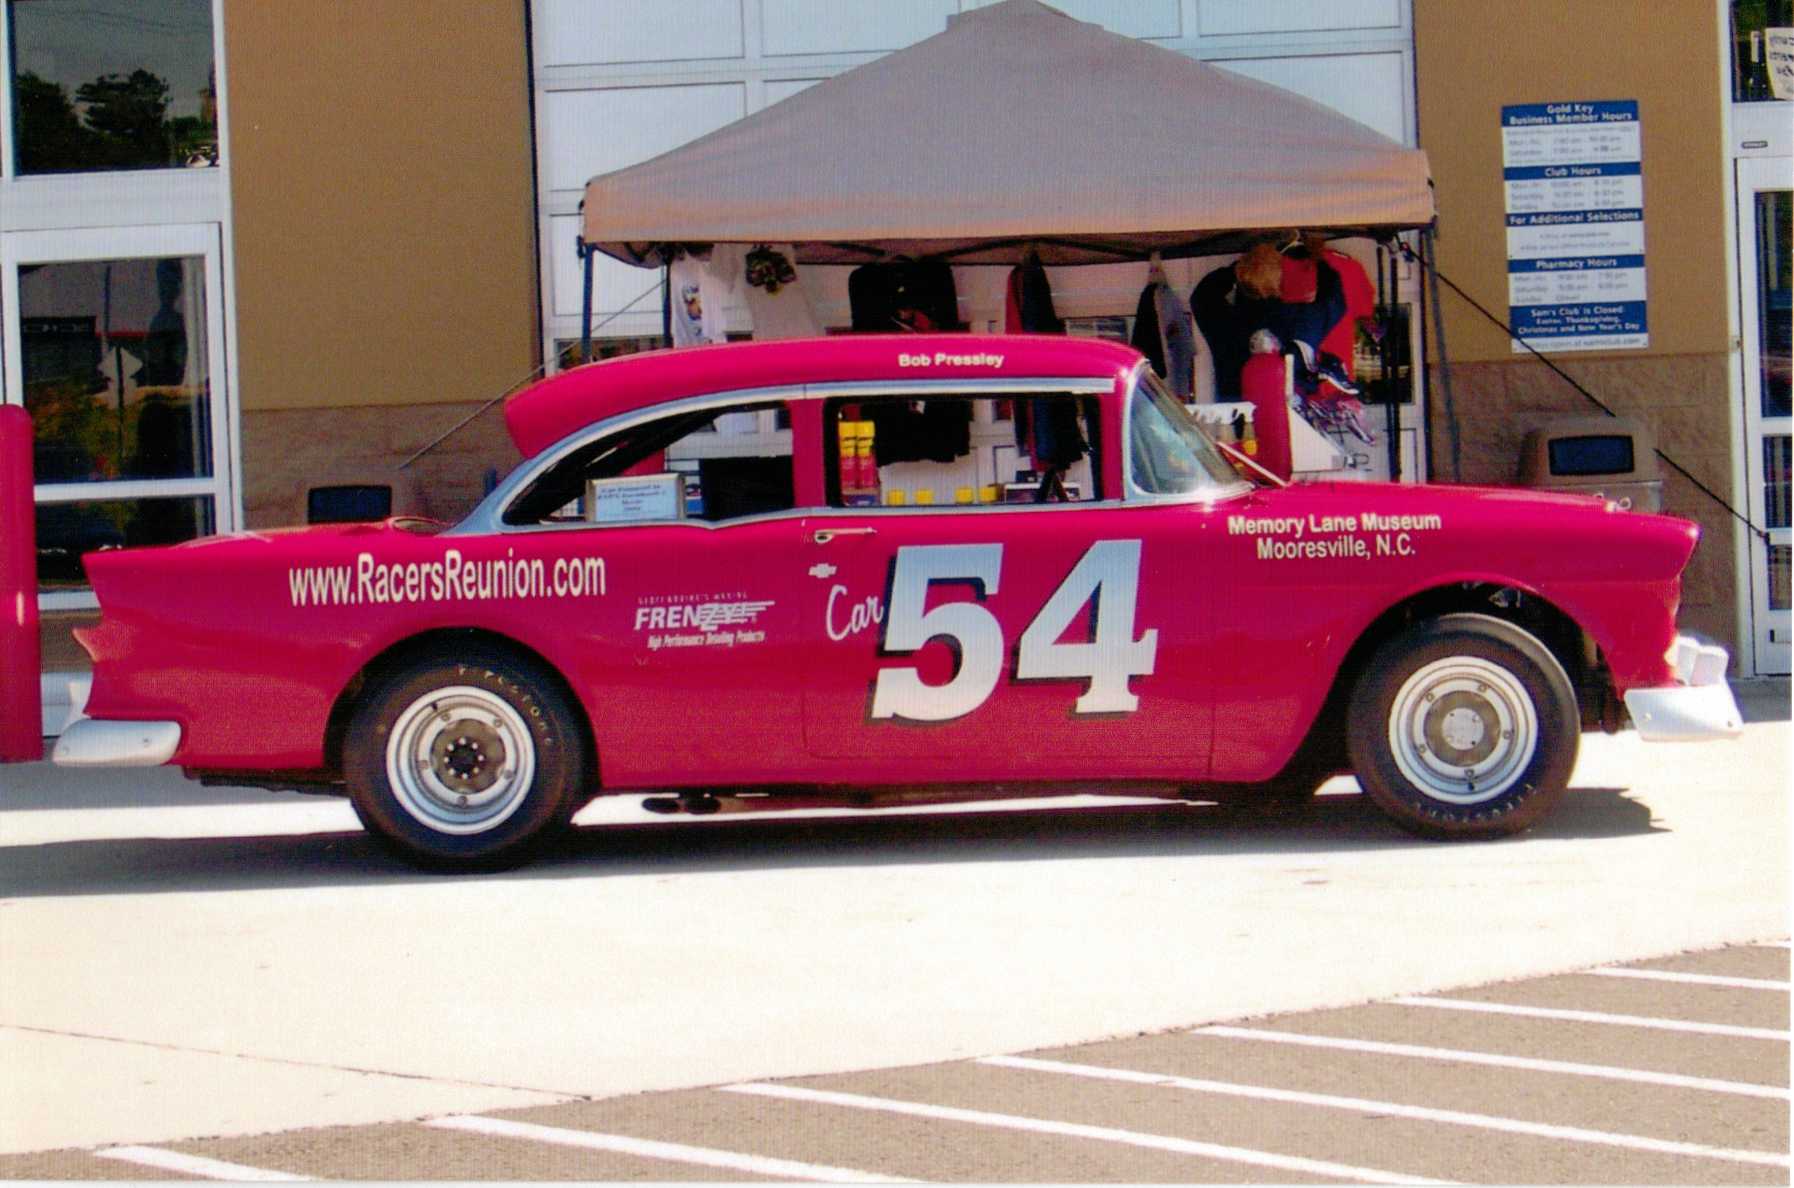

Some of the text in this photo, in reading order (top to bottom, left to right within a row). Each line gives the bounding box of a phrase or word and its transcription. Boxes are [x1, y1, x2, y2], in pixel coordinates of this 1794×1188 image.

[1547, 102, 1594, 115] Gold Key
[1510, 111, 1633, 125] Business Member Hours
[1544, 166, 1602, 177] Club Hours
[1509, 211, 1640, 225] For Additional Selections
[1536, 258, 1617, 270] Pharmacy Hours
[1530, 308, 1556, 317] Sam's
[1559, 306, 1580, 316] Club
[1593, 305, 1624, 314] Closed
[1517, 326, 1558, 335] Christmas
[1560, 324, 1576, 332] and
[1577, 323, 1596, 332] New
[1625, 322, 1640, 331] Day
[898, 352, 1004, 369] Bob Pressley
[1227, 512, 1442, 538] Memory Lane Museum
[1256, 533, 1416, 560] Mooresville, N.C.
[288, 547, 606, 607] www.RacersReunion.com
[826, 539, 1158, 724] Car 54
